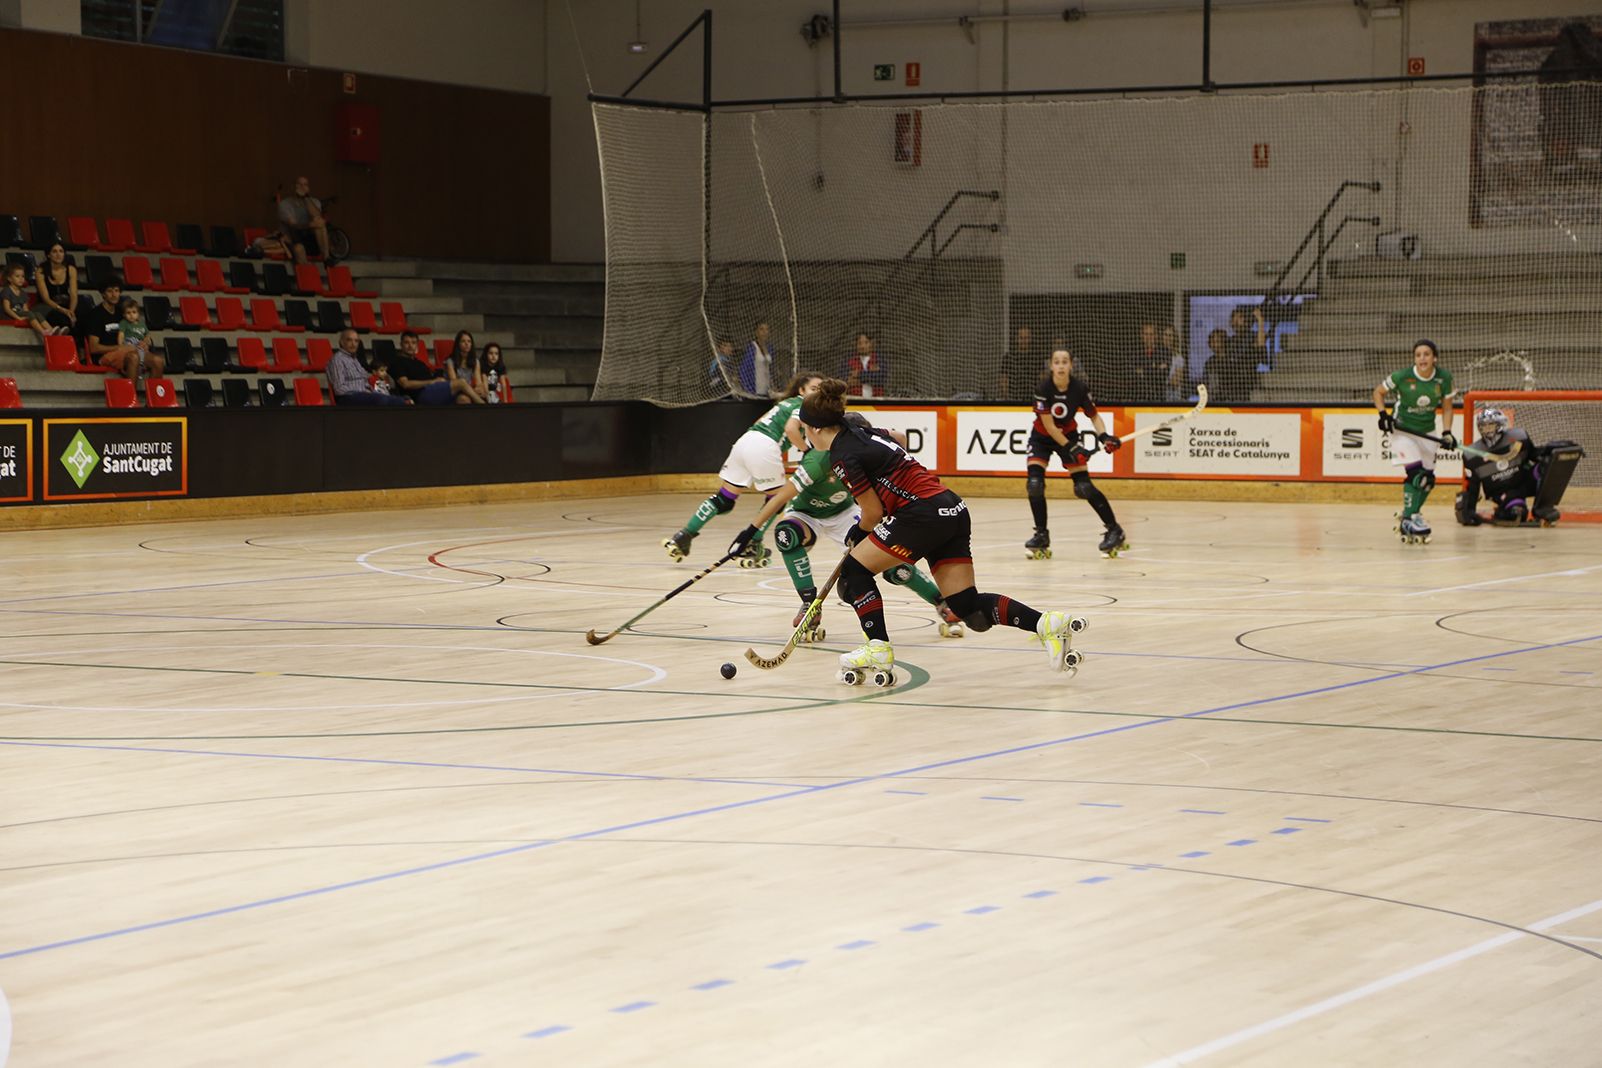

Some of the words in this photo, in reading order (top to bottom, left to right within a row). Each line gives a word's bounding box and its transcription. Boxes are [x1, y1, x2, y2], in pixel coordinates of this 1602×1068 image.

[1189, 427, 1221, 437] Xarxa
[1223, 427, 1237, 437] de
[103, 442, 160, 455] AJUNTAMENT
[161, 442, 173, 454] DE
[1189, 438, 1270, 448] Concessionaris
[3, 445, 16, 458] DE
[1189, 449, 1215, 458] SEAT
[1217, 449, 1230, 458] de
[1233, 449, 1290, 461] Catalunya
[103, 455, 173, 476] SantCugat
[755, 652, 788, 668] AZEMAD
